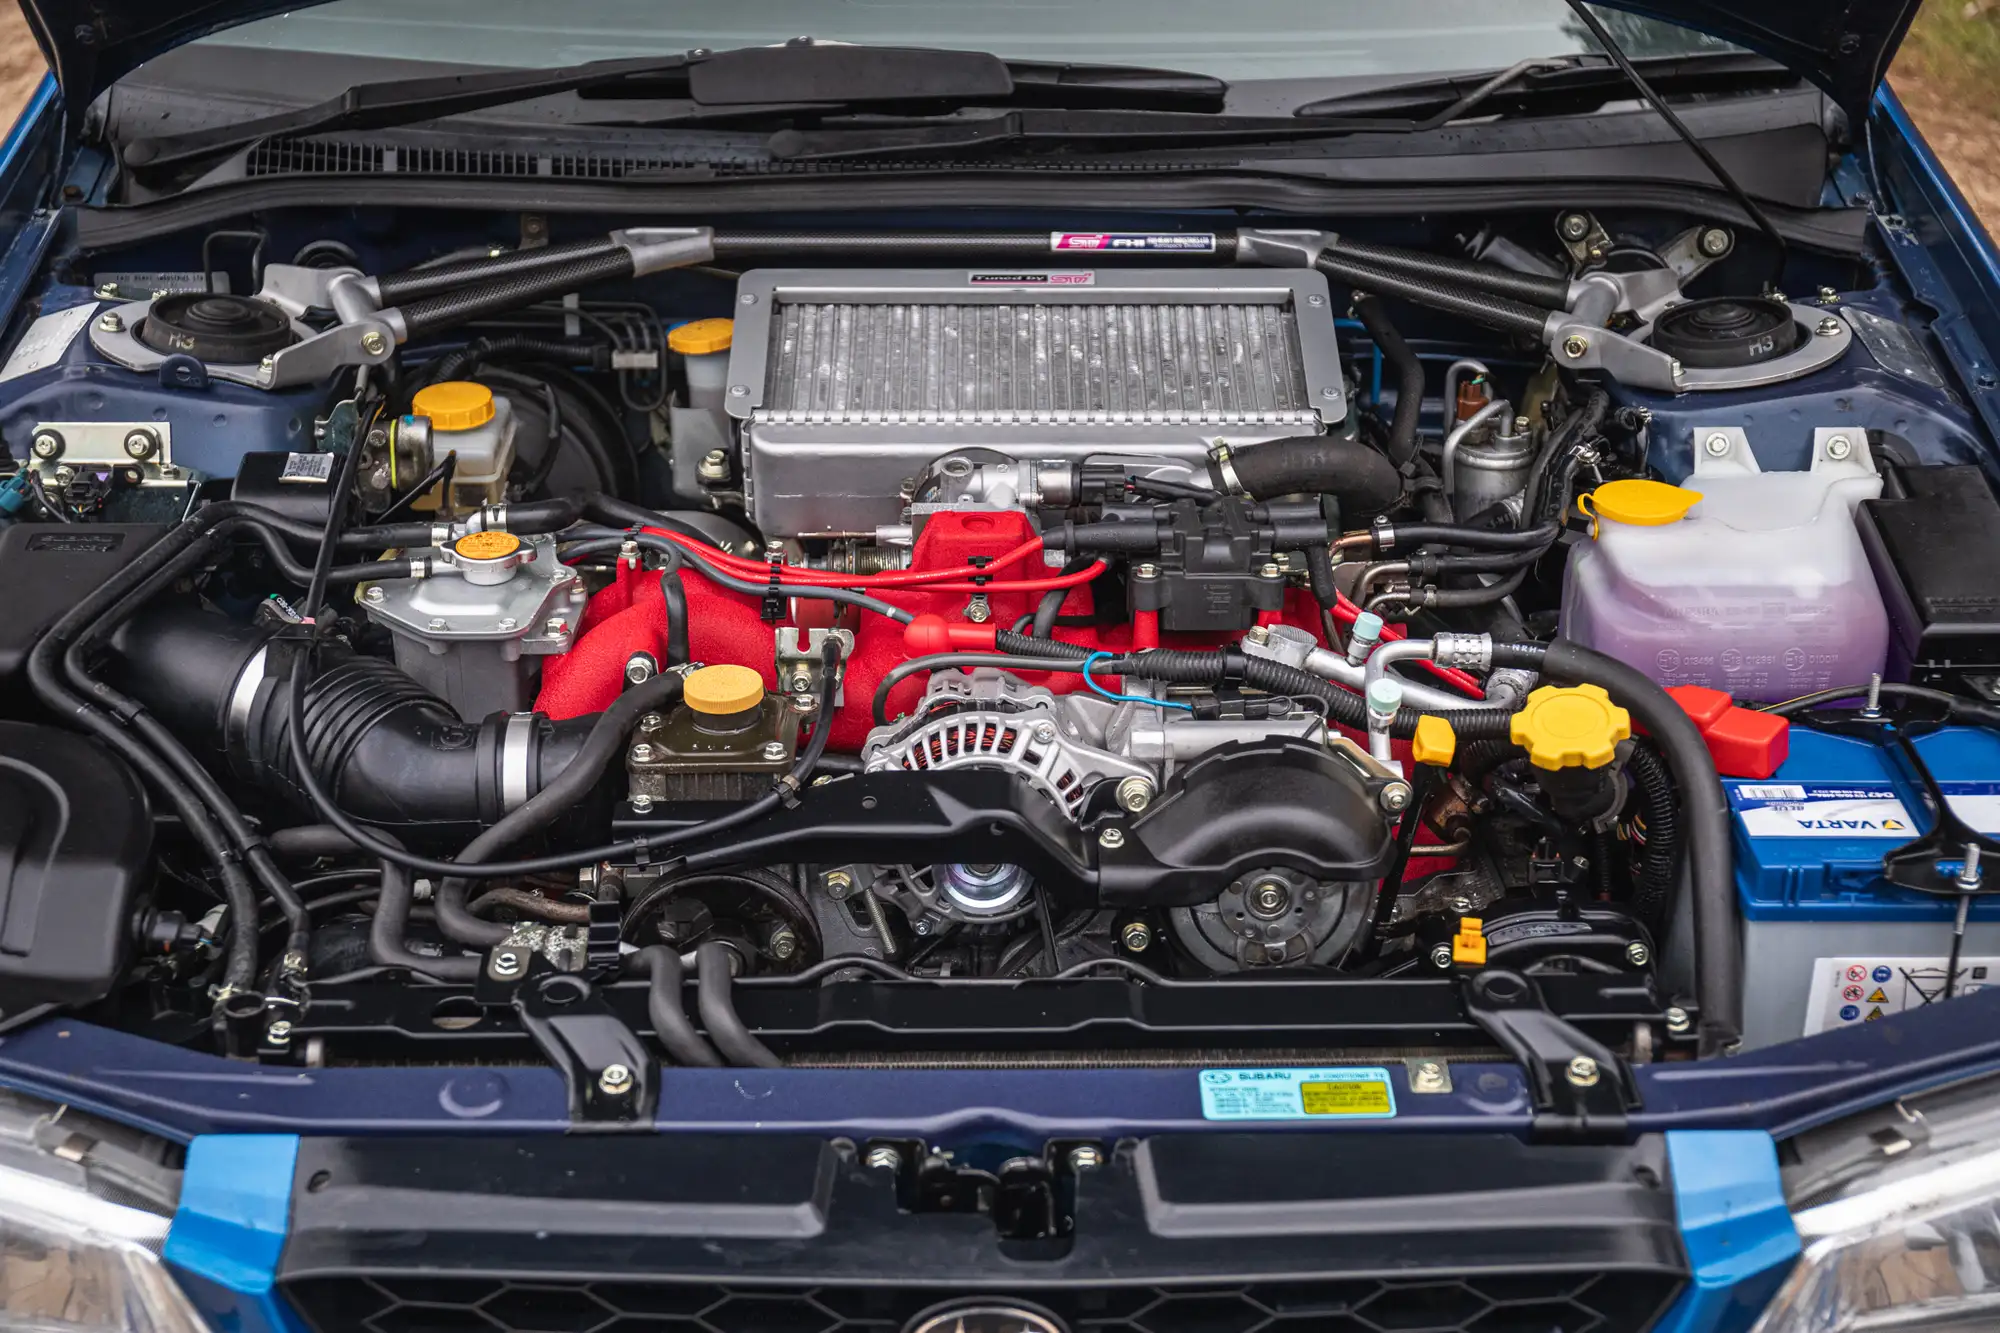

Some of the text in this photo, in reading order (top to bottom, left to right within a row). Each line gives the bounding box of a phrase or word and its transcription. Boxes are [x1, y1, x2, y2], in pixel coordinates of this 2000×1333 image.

[1112, 238, 1146, 248] FHI
[1797, 819, 1877, 829] VARTA
[1238, 1073, 1292, 1081] SUBARU
